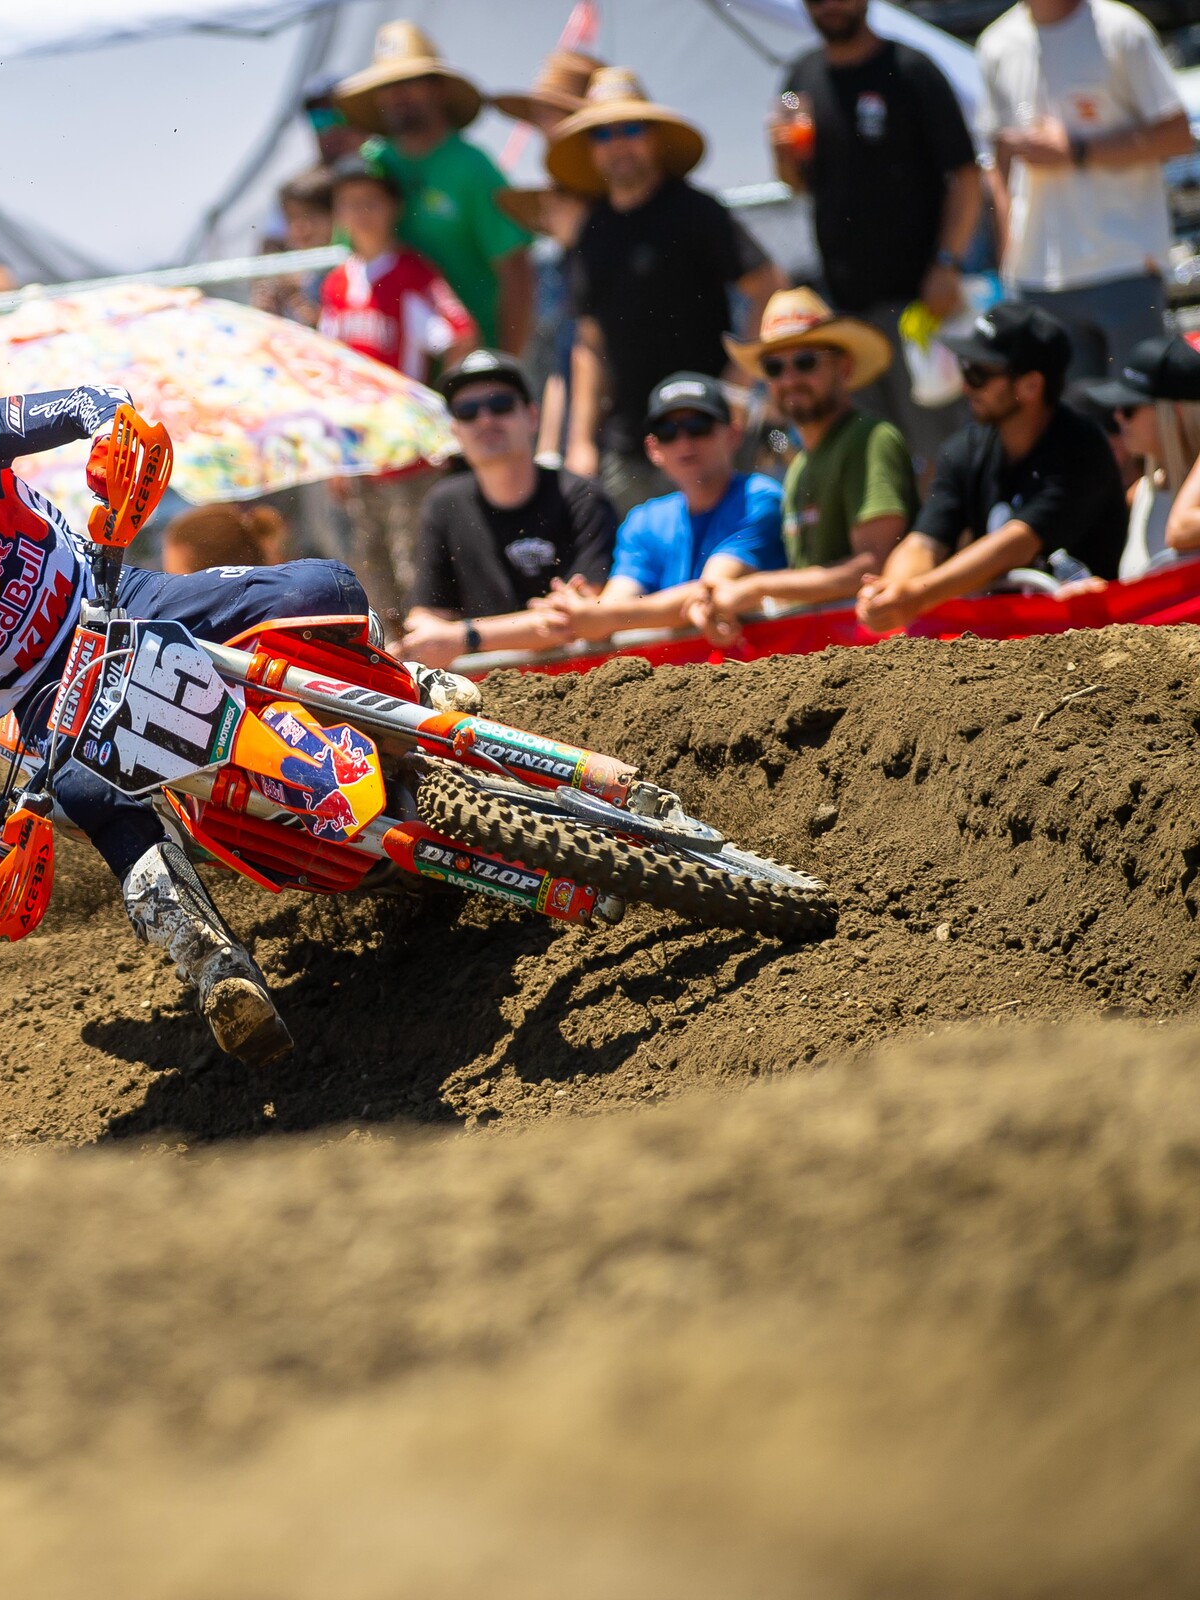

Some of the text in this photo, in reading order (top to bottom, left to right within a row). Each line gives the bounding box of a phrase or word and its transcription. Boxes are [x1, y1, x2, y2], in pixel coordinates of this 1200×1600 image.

[0, 537, 46, 611] Bull
[13, 569, 73, 673] KTM
[106, 660, 125, 688] OIL
[114, 629, 226, 780] 115
[218, 706, 237, 748] MOTOREX
[470, 717, 554, 751] MOTOREX
[419, 844, 541, 891] DULOP
[448, 874, 534, 909] MOTOREX
